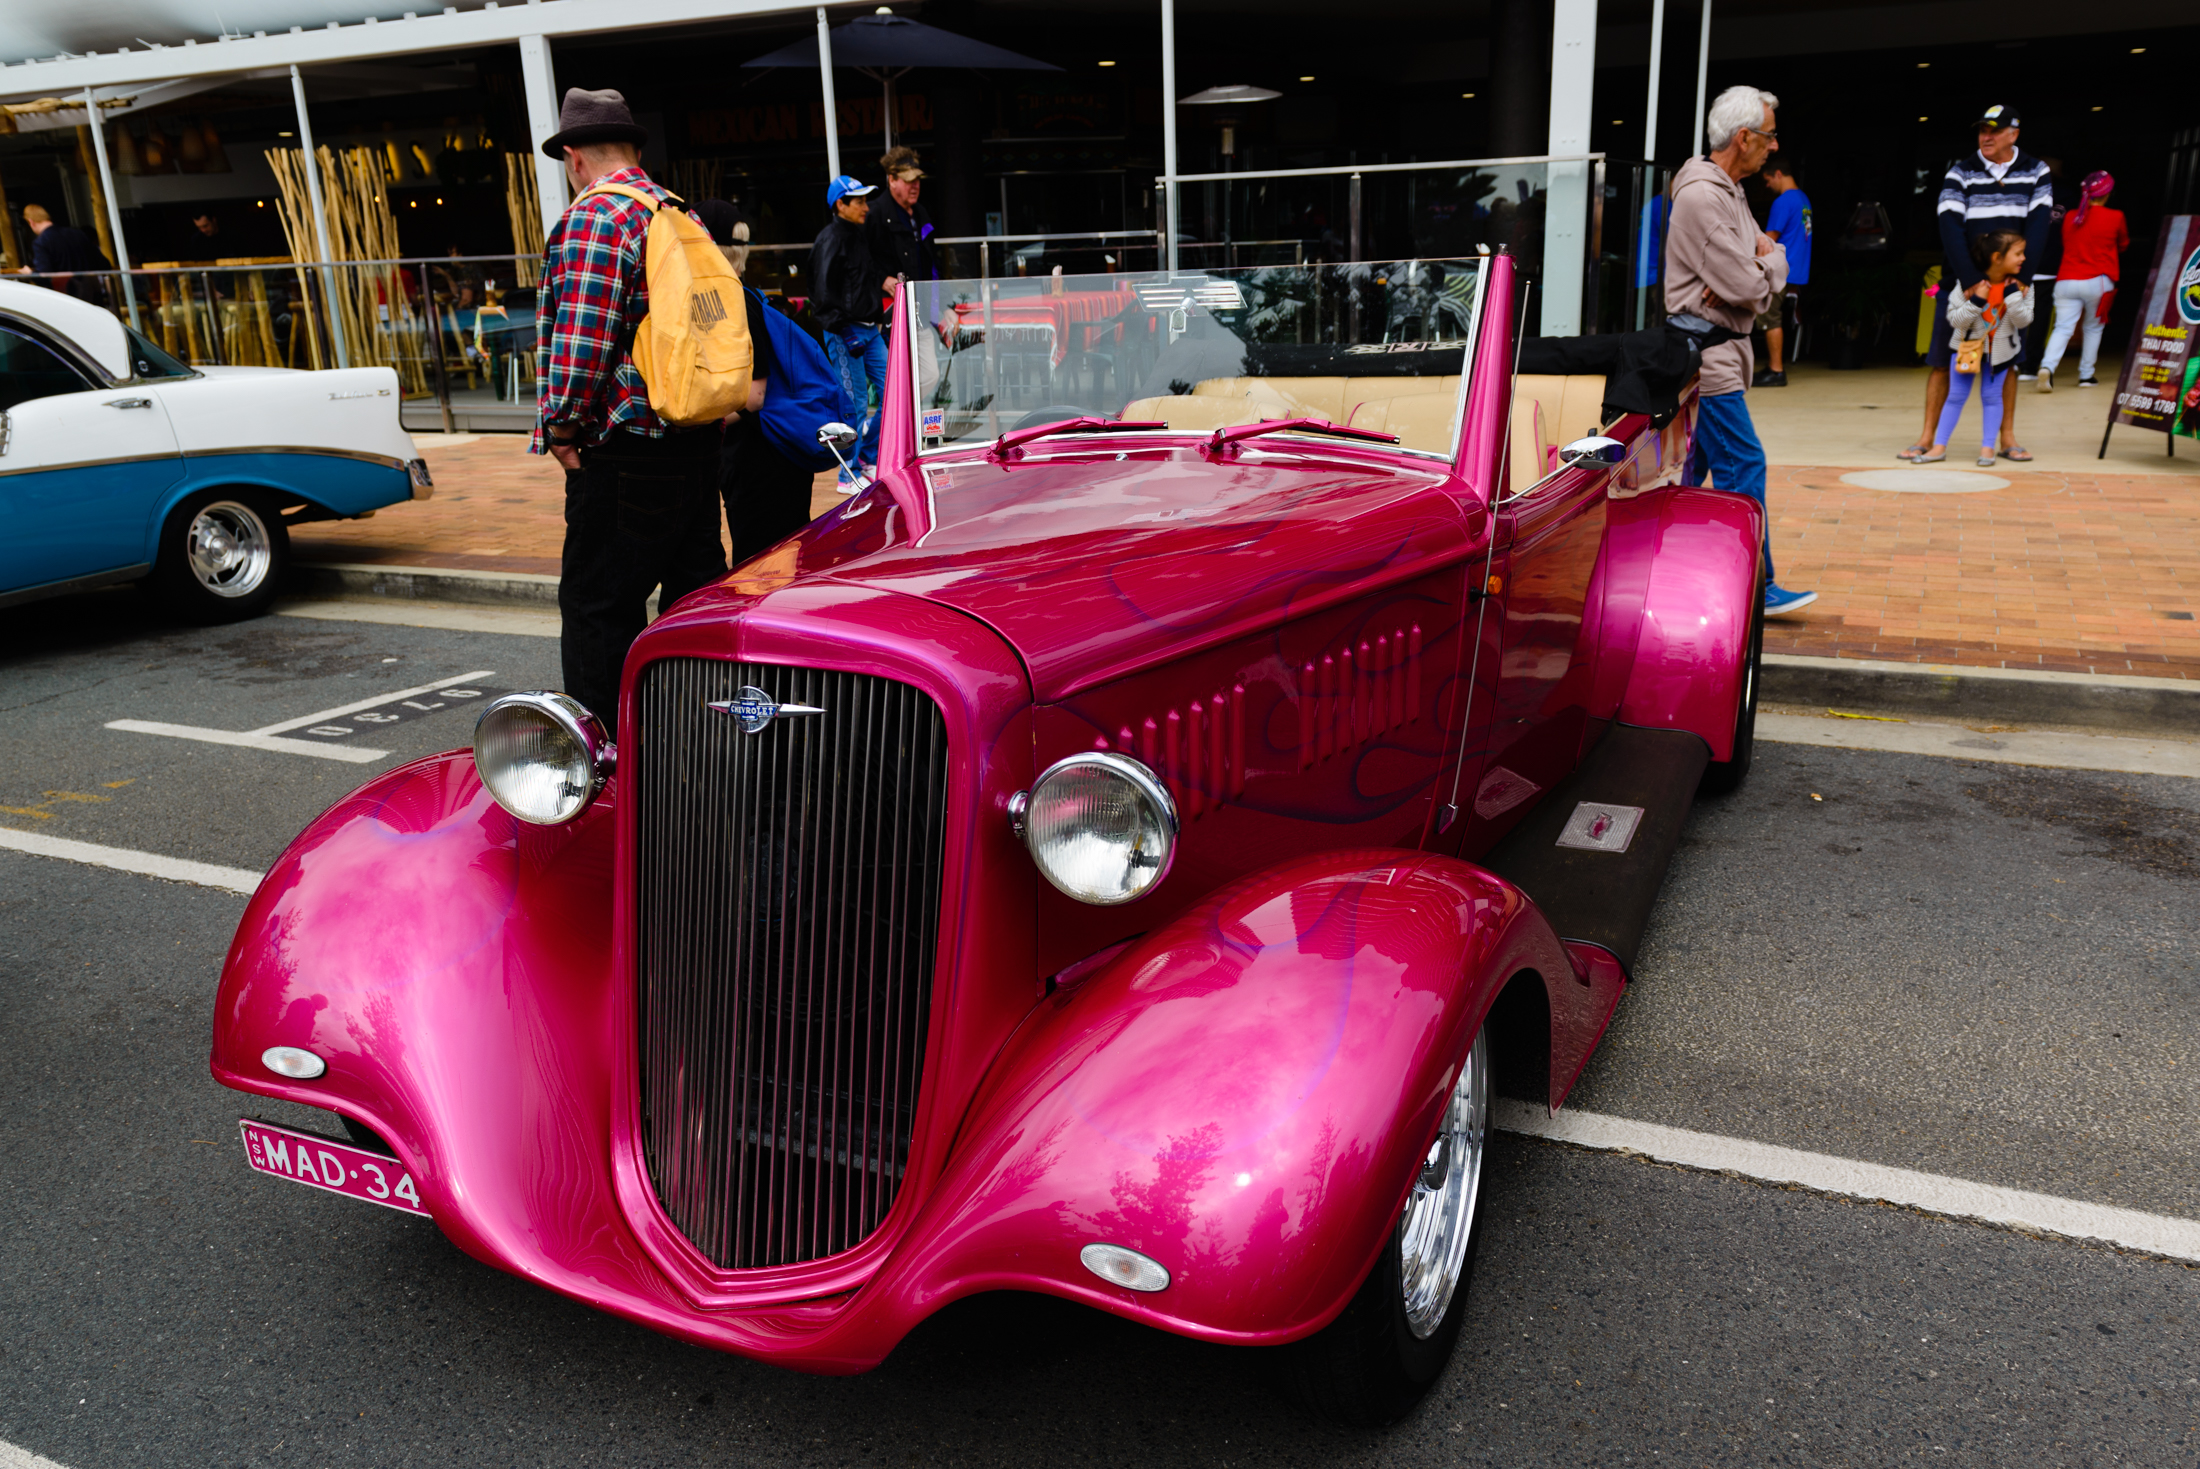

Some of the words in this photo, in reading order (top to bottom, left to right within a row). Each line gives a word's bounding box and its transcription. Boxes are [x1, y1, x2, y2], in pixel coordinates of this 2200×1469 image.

[688, 103, 798, 146] MEXICAN
[2144, 323, 2188, 339] Authentic
[2141, 338, 2160, 351] THAI
[2161, 340, 2185, 354] FOOD
[2117, 392, 2131, 405] 07
[2129, 395, 2153, 410] 5599
[2153, 399, 2176, 414] 1788
[924, 415, 942, 425] ASRF
[730, 705, 774, 716] CHEVROLET
